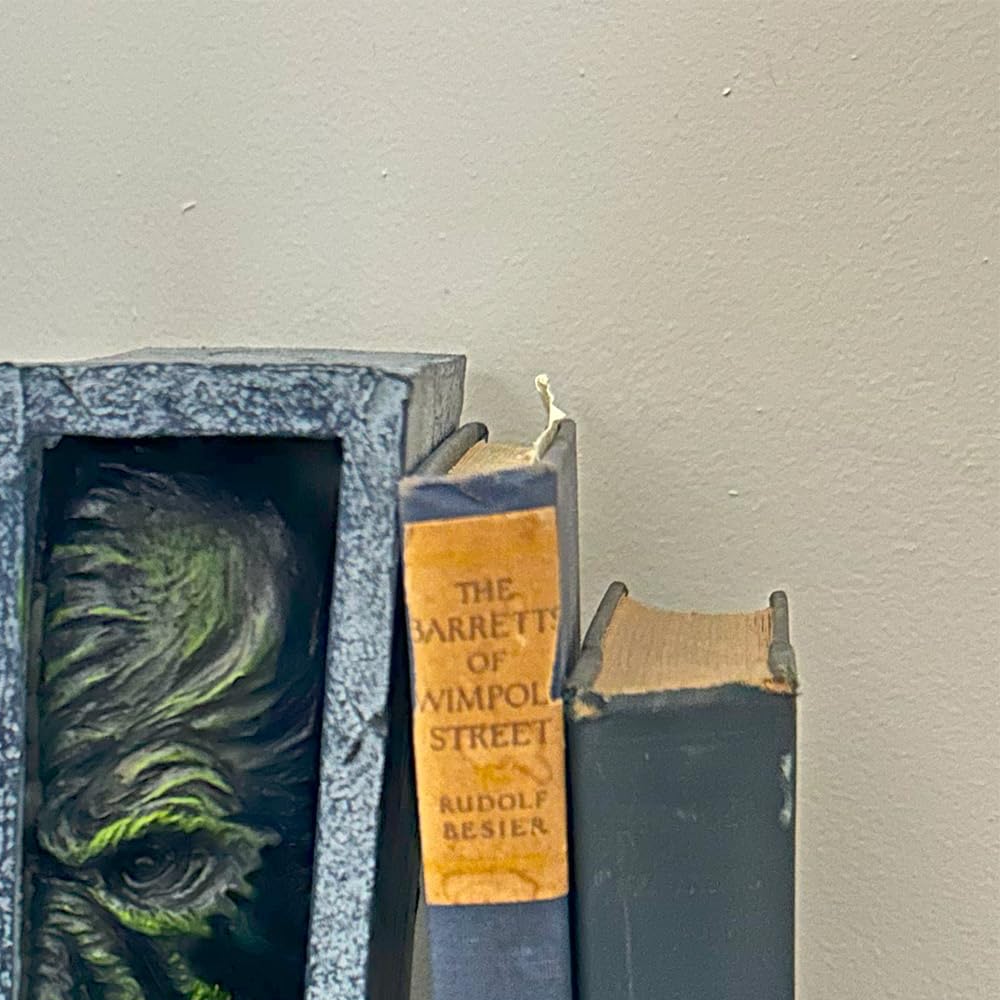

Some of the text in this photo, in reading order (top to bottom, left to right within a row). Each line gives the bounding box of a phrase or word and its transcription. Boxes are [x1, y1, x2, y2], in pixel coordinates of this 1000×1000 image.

[454, 576, 513, 605] THE
[465, 650, 507, 675] OF
[429, 717, 553, 751] STREET
[439, 789, 548, 815] RUDOLF
[442, 815, 549, 841] BESIER
